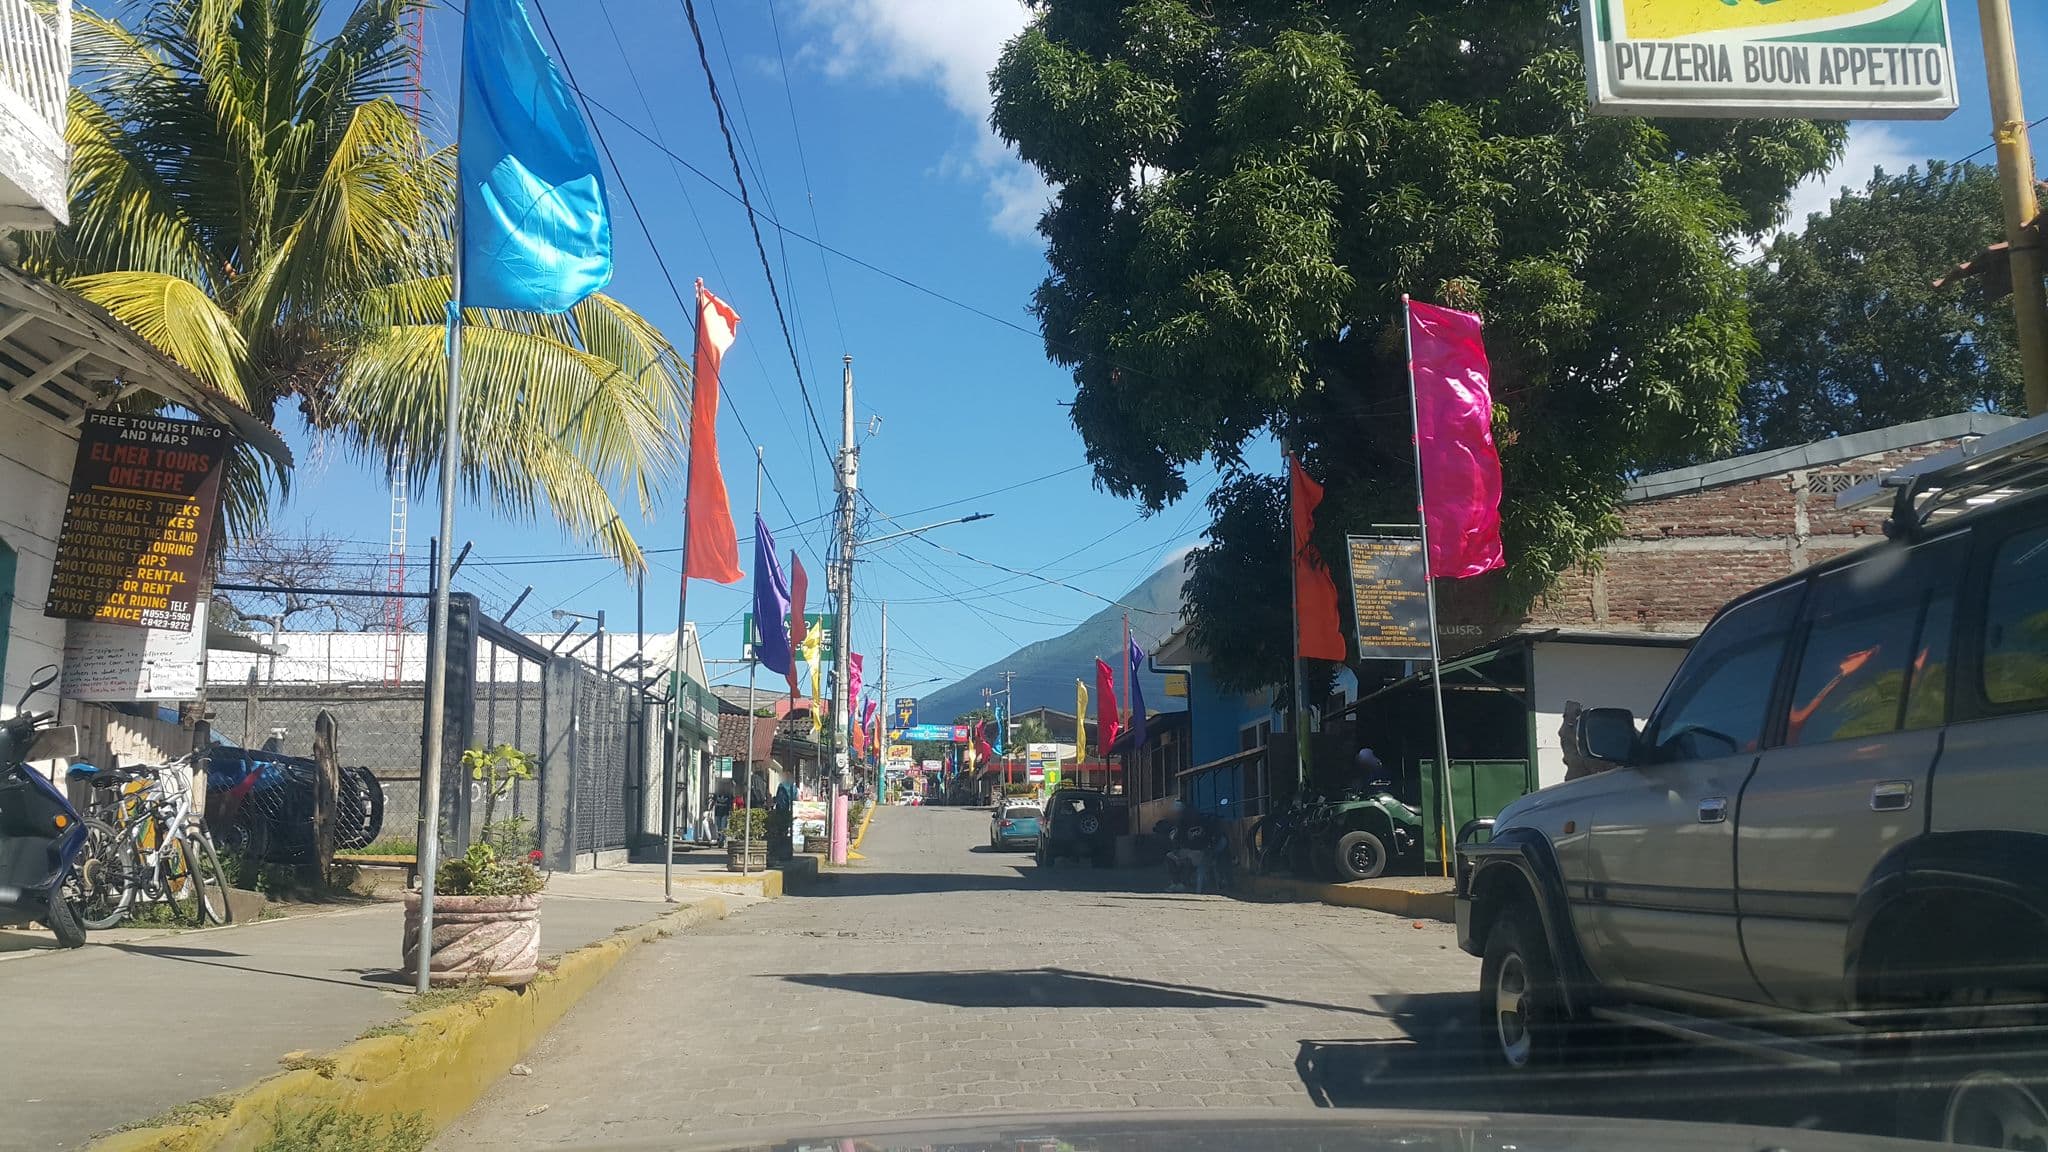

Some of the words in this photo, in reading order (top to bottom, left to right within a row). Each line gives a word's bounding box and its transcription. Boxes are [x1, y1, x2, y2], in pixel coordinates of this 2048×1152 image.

[1615, 42, 1733, 83] PIZZERIA
[1743, 45, 1811, 85] BUON
[1819, 47, 1942, 86] APPETITO
[90, 414, 126, 427] FREE
[132, 419, 189, 434] TOURIST
[190, 425, 221, 438] INFO
[120, 429, 147, 441] AND
[151, 432, 189, 446] MAPS
[90, 442, 149, 466] ELMER
[155, 448, 210, 472] TOURS
[108, 466, 185, 491] OMETEPE
[74, 492, 153, 512] VOLCANOES
[158, 501, 201, 517] TREKS
[71, 505, 150, 525] WATERFALL
[155, 516, 195, 529] HIKES
[68, 519, 99, 533] TOURS
[102, 522, 140, 537] AROUND
[143, 527, 161, 539] THE
[163, 529, 198, 543] ISLAND
[64, 532, 142, 551] MOTORCYCLE
[146, 541, 194, 556] TOURING
[62, 546, 125, 562] KAYAKING
[131, 553, 168, 568] TRIPS
[57, 572, 113, 589] BICYCLES
[116, 579, 139, 592] FOR
[142, 582, 173, 595] RENT
[59, 560, 134, 578] MOTORBIKE
[137, 567, 187, 584] RENTAL
[54, 586, 92, 600] HORSE
[95, 590, 125, 605] BACK
[129, 595, 168, 609] RIDING
[170, 600, 189, 612] TELF
[53, 600, 83, 614] TAXI
[87, 604, 142, 620] SERVICE
